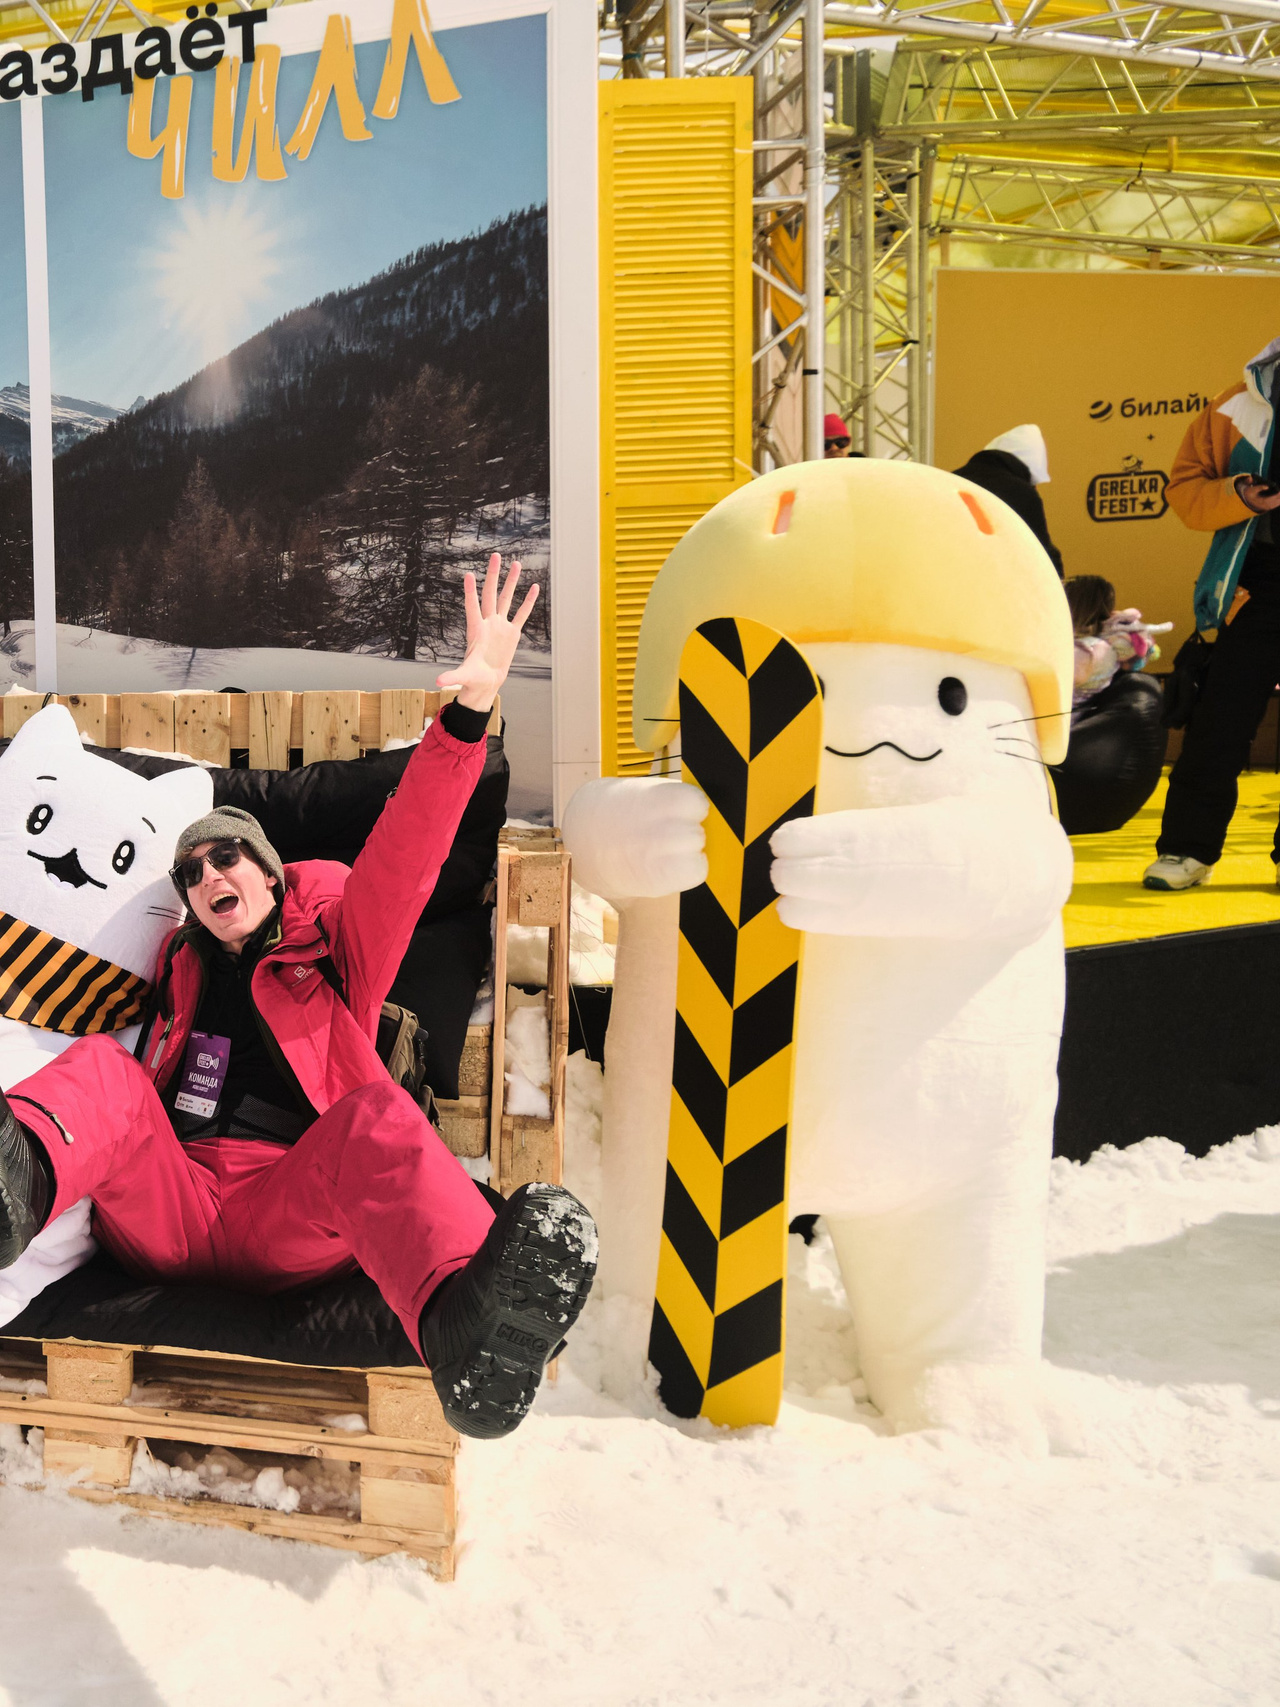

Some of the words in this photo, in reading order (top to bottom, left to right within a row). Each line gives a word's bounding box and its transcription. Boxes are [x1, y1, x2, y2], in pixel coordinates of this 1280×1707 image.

[1099, 477, 1159, 497] GRELKA
[1099, 498, 1139, 515] FEST
[188, 1072, 218, 1089] КОМАНДА
